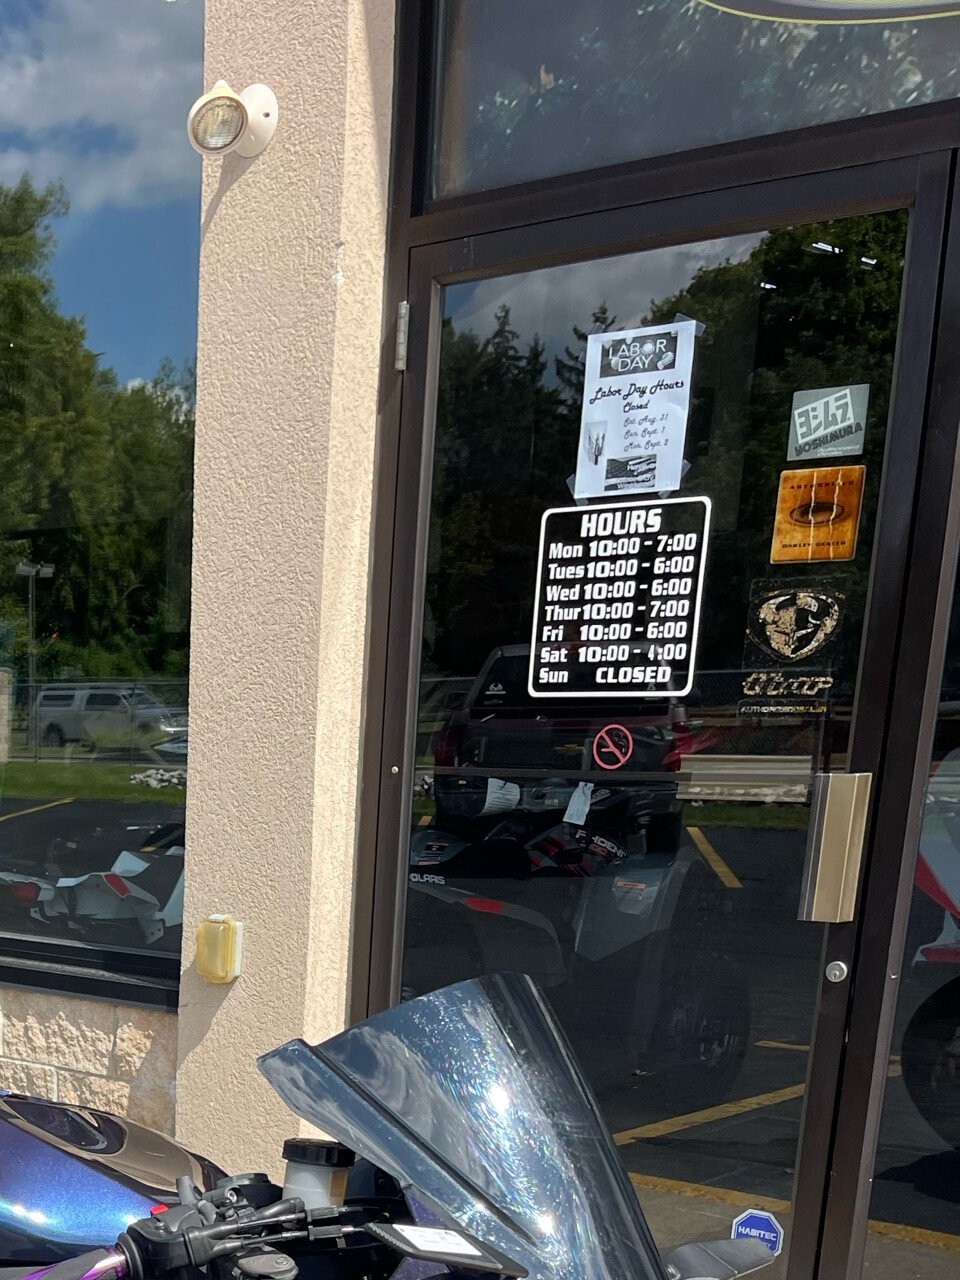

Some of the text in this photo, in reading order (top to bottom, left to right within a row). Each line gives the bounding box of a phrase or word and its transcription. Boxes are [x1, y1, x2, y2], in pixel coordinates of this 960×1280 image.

[618, 355, 653, 371] DAY
[589, 379, 684, 404] Labor Day Hours
[794, 421, 863, 457] YOSHIMURA
[580, 508, 662, 538] HOURS
[548, 542, 583, 559] Mon
[589, 538, 640, 557] 10:00
[657, 533, 697, 552] 7:00
[548, 563, 584, 579] Tues
[587, 559, 638, 578] 10:00
[653, 556, 694, 574] 6:00
[546, 584, 580, 601] Wed
[583, 581, 636, 599] 10:00
[651, 578, 692, 596] 6:00
[545, 604, 581, 621] Thur
[582, 602, 633, 619] 10:00
[650, 600, 690, 618] 7:00
[542, 625, 563, 641] Fri
[580, 623, 631, 640] 10:00
[647, 621, 687, 638] 6:00
[540, 647, 568, 662] Sat
[578, 645, 629, 662] 10:00
[648, 643, 687, 660] 4:00
[539, 666, 671, 683] Sun CLOSED
[409, 873, 446, 885] OLARIS
[738, 1225, 778, 1241] HABITEC
